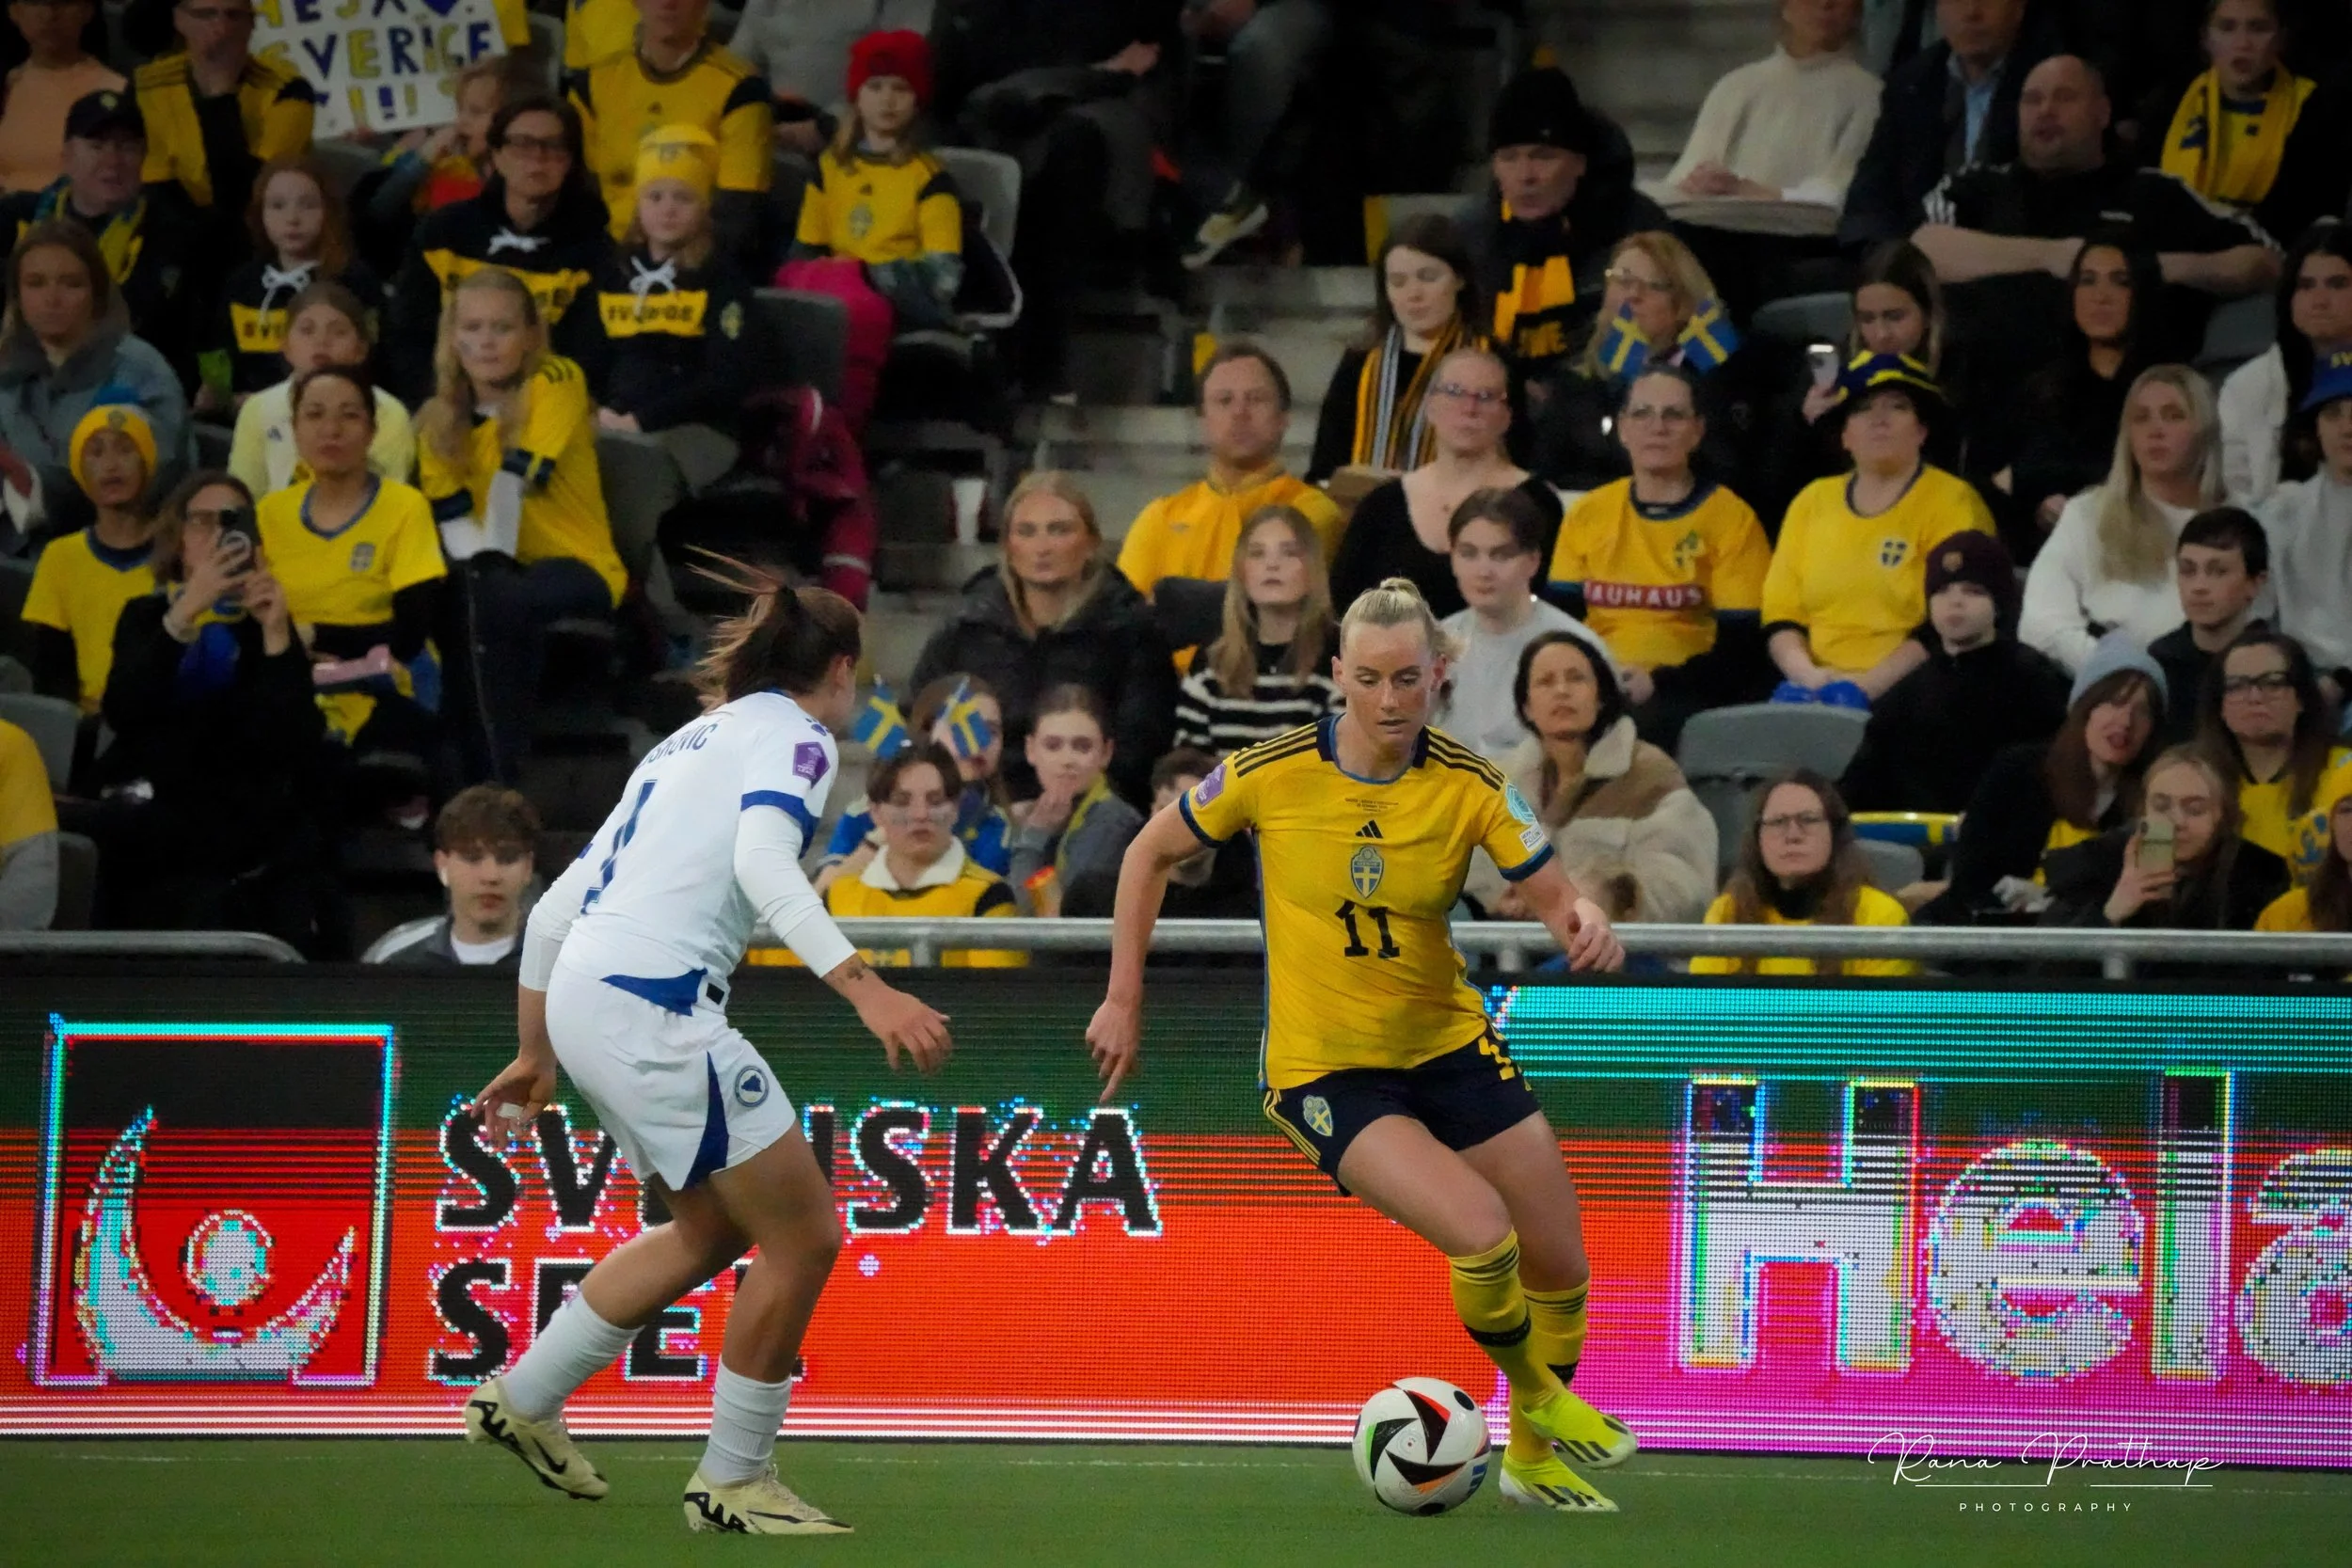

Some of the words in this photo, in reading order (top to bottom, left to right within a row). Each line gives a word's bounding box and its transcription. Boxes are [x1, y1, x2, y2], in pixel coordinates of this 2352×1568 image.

[1335, 899, 1400, 958] 11
[436, 1101, 1163, 1237] SVSKA
[1678, 1067, 2352, 1386] Hela
[427, 1257, 807, 1386] SE
